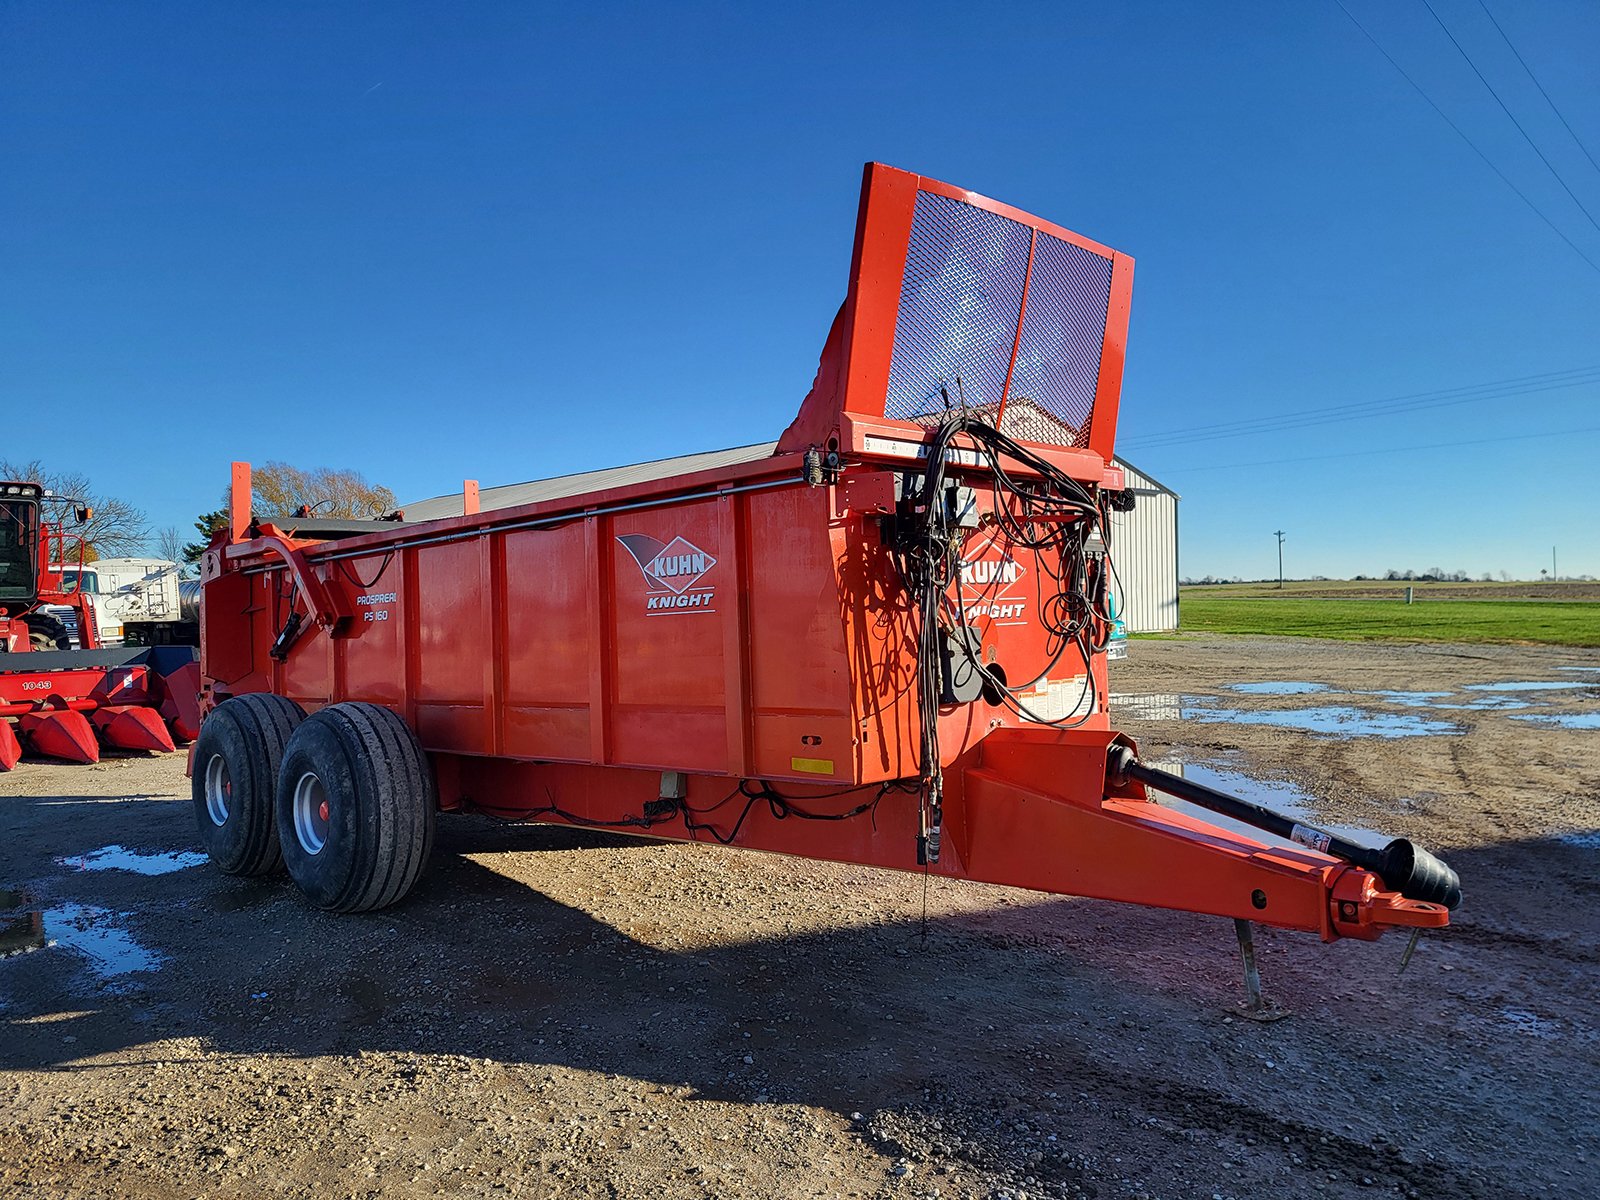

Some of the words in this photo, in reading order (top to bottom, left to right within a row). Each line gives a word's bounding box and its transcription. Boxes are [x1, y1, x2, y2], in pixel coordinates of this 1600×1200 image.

[654, 553, 705, 577] KUHN
[647, 593, 714, 609] KNIGHT
[364, 612, 373, 621] PS
[375, 611, 388, 621] 160
[22, 681, 52, 690] 1043
